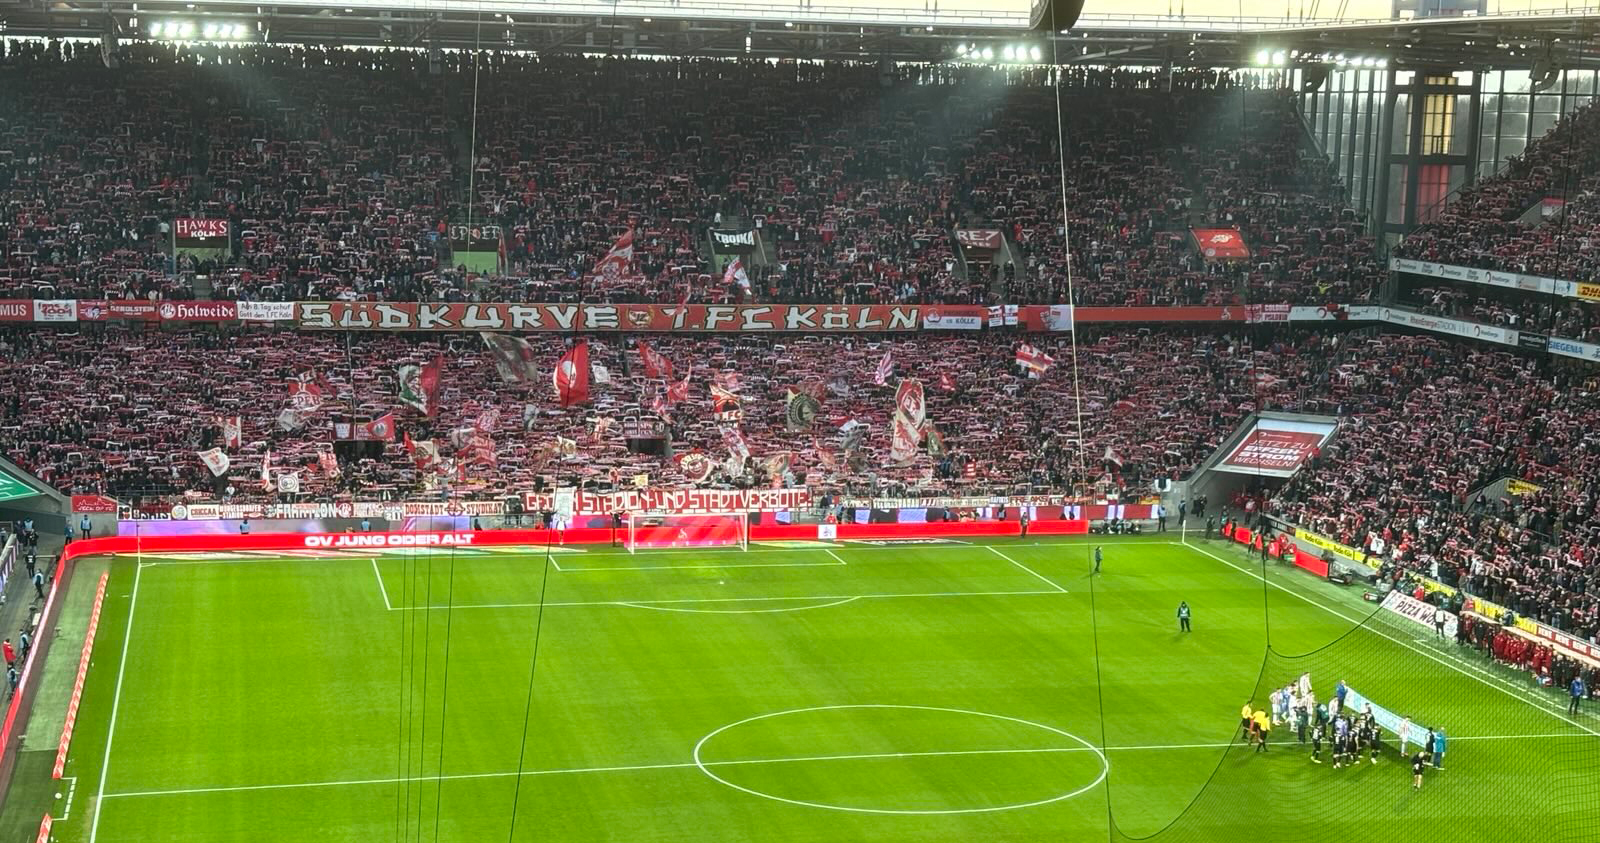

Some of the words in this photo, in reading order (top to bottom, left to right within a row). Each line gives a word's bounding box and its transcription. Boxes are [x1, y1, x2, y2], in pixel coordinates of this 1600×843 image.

[176, 220, 227, 234] HAWKS
[191, 229, 216, 238] KÖLN
[177, 303, 234, 320] Holweide
[300, 303, 620, 329] SÜDKURVE
[785, 305, 918, 330] KÖLN
[1243, 445, 1305, 455] EFFZEH-
[1249, 439, 1296, 448] JETZT
[1292, 441, 1311, 450] ZU
[1238, 451, 1301, 461] STROM
[405, 503, 444, 515] DOMSTADT
[466, 502, 503, 515] SYNDIKAT
[304, 535, 334, 547] OV
[335, 535, 387, 546] JUNG
[387, 534, 441, 546] ODER
[441, 533, 475, 545] ALT
[1394, 600, 1420, 619] PIZZA
[1420, 612, 1437, 626] WO
